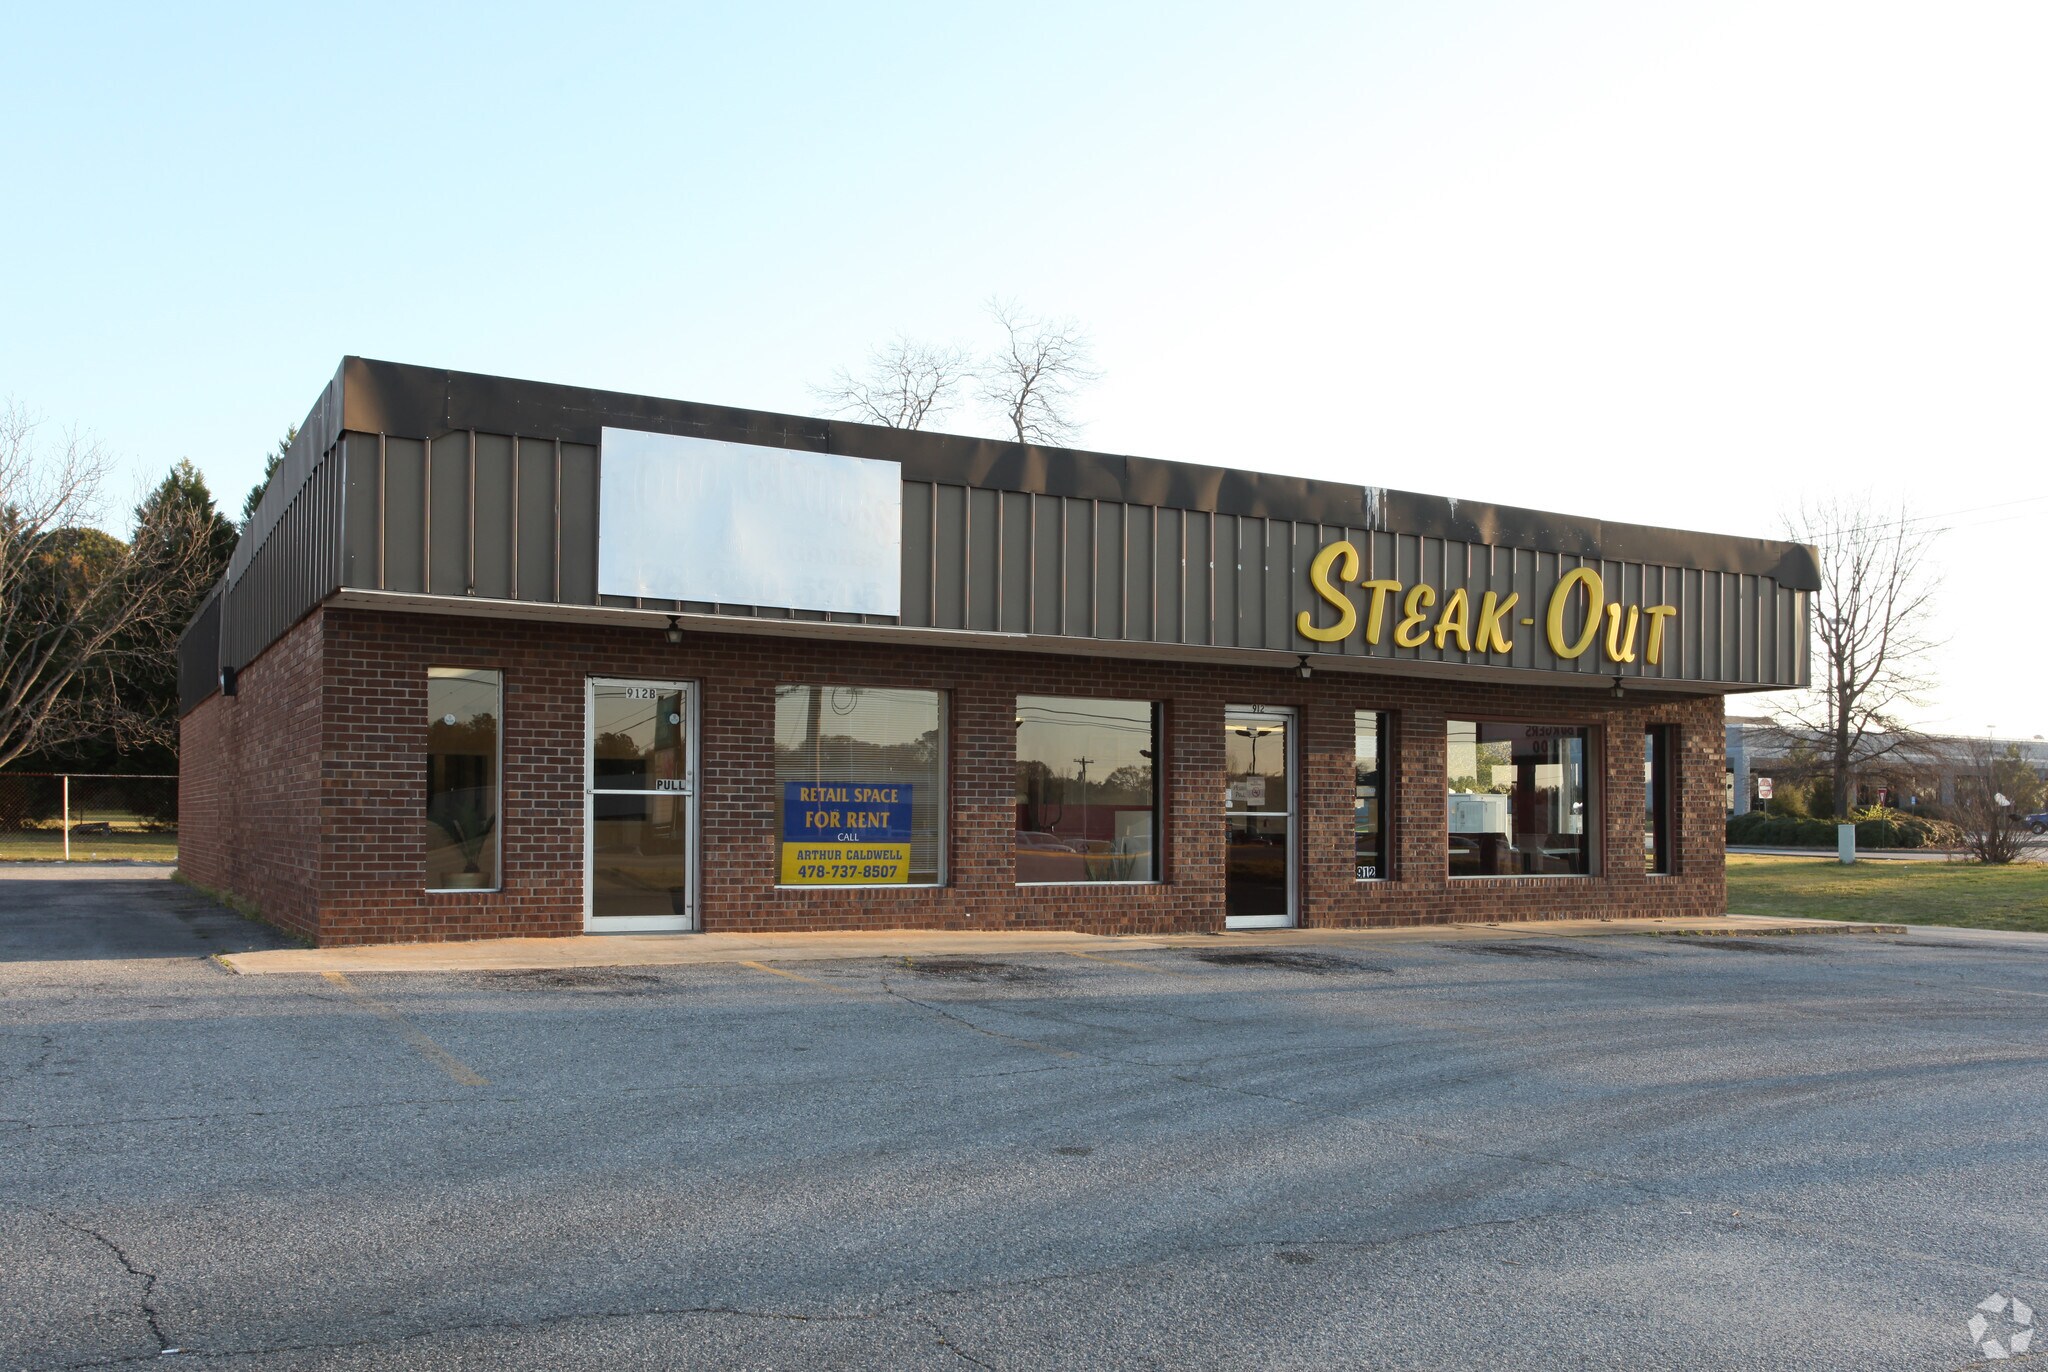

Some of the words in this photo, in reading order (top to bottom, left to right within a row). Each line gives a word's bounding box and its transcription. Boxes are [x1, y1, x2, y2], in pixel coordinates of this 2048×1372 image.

[626, 688, 656, 699] 912B
[1252, 704, 1265, 713] 912
[656, 780, 685, 790] PULL
[800, 787, 849, 803] RETAIL
[854, 788, 899, 803] SPACE
[805, 811, 841, 828] FOR
[847, 811, 890, 828] RENT
[837, 833, 859, 842] CALL
[797, 850, 842, 860] ARTHUR
[846, 850, 902, 860] CALDWELL
[798, 865, 897, 879] 478-737-8507
[1357, 867, 1376, 878] 912
